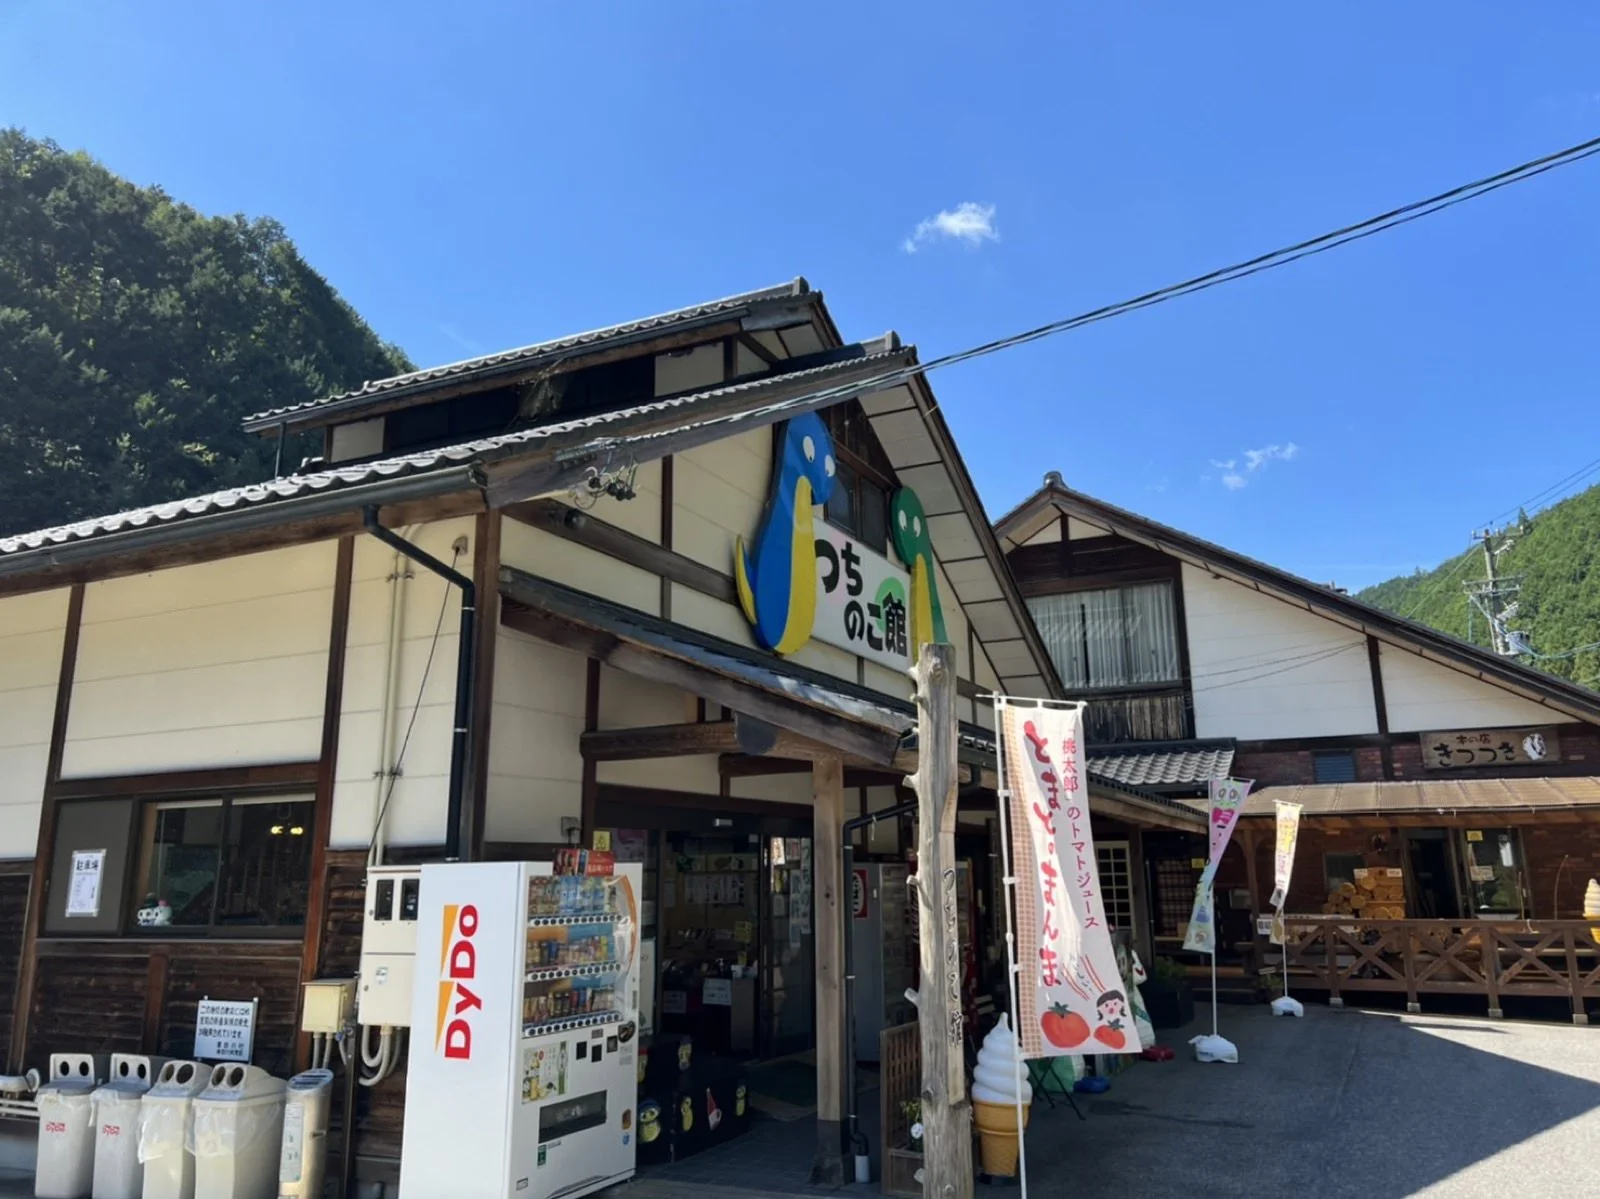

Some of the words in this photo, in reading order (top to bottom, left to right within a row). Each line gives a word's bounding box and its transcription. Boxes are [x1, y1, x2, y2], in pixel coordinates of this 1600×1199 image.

[814, 539, 863, 596] つち
[844, 592, 907, 657] のこ館
[1433, 742, 1516, 767] きつつき
[1456, 733, 1492, 745] 木の店
[444, 904, 482, 1060] DyDo
